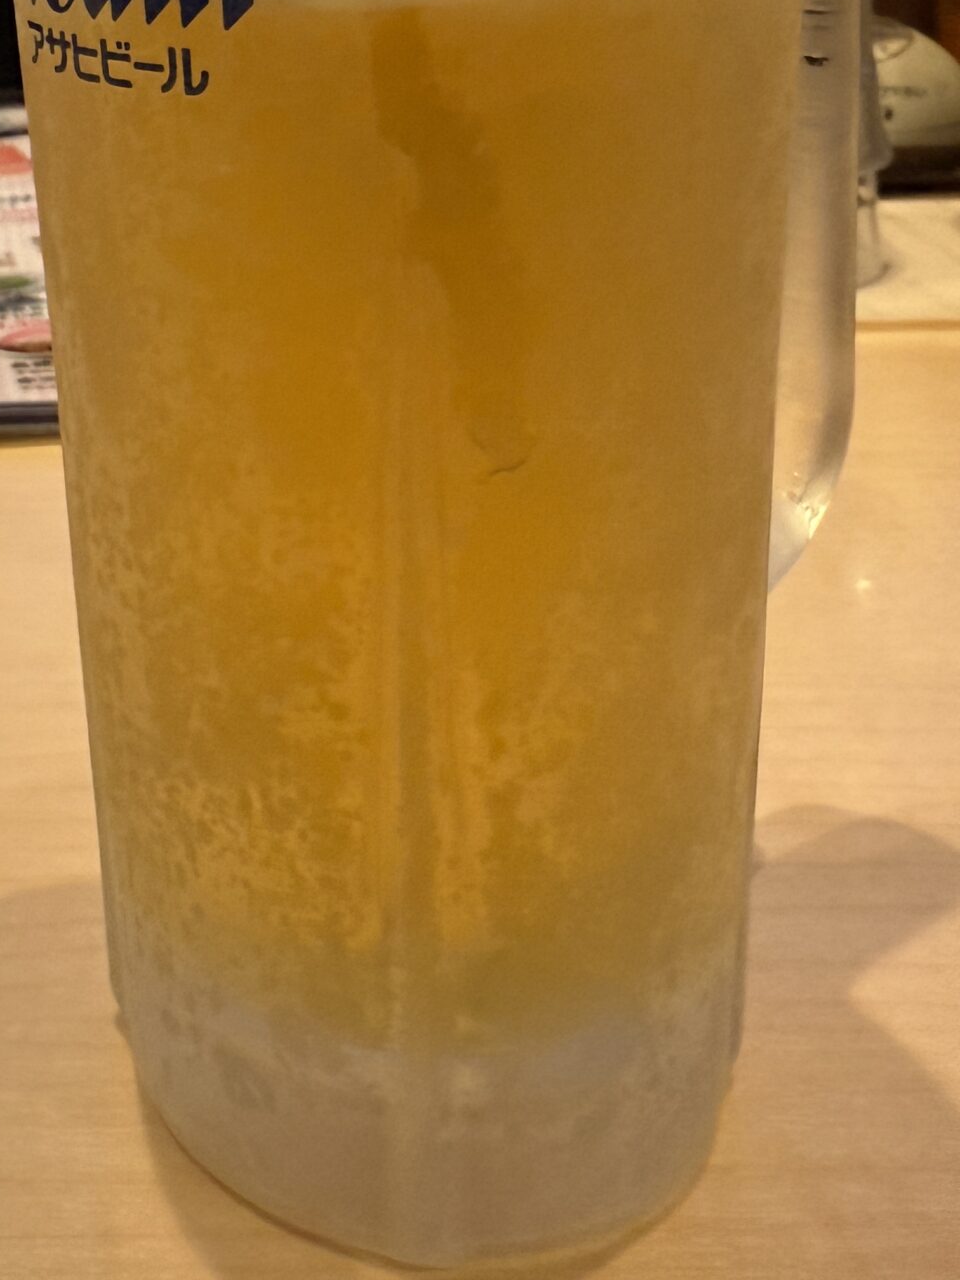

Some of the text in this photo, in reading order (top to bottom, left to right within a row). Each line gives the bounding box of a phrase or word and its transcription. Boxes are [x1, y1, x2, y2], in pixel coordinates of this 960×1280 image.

[27, 20, 209, 96] アサヒビール
